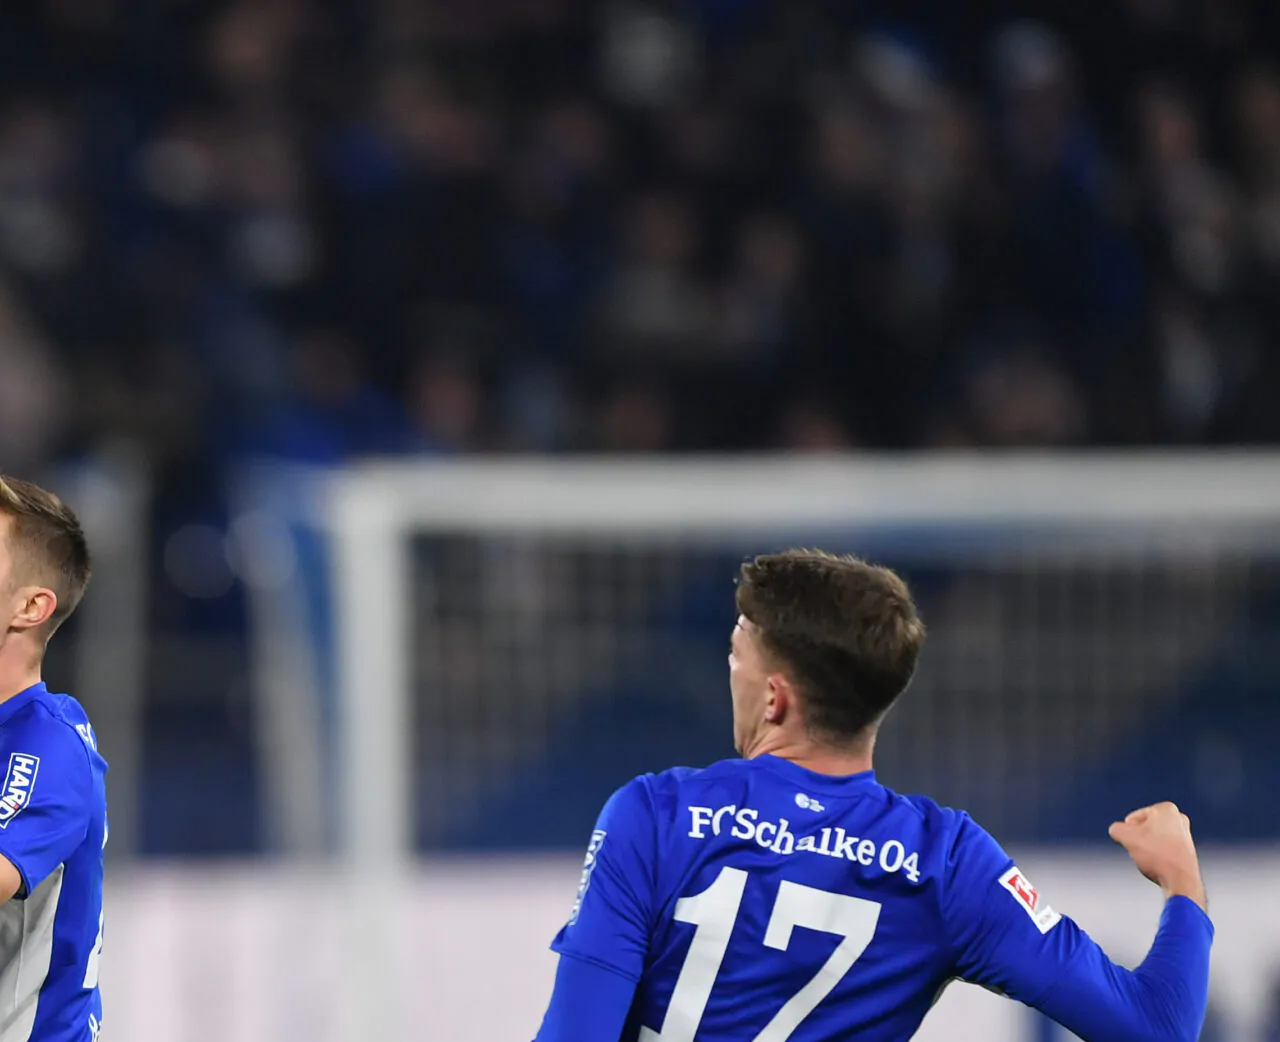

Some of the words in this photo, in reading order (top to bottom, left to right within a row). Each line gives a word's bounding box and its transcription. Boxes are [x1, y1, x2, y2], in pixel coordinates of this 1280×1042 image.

[688, 805, 736, 839] FC
[731, 808, 876, 866] Schalke
[879, 840, 921, 882] 04
